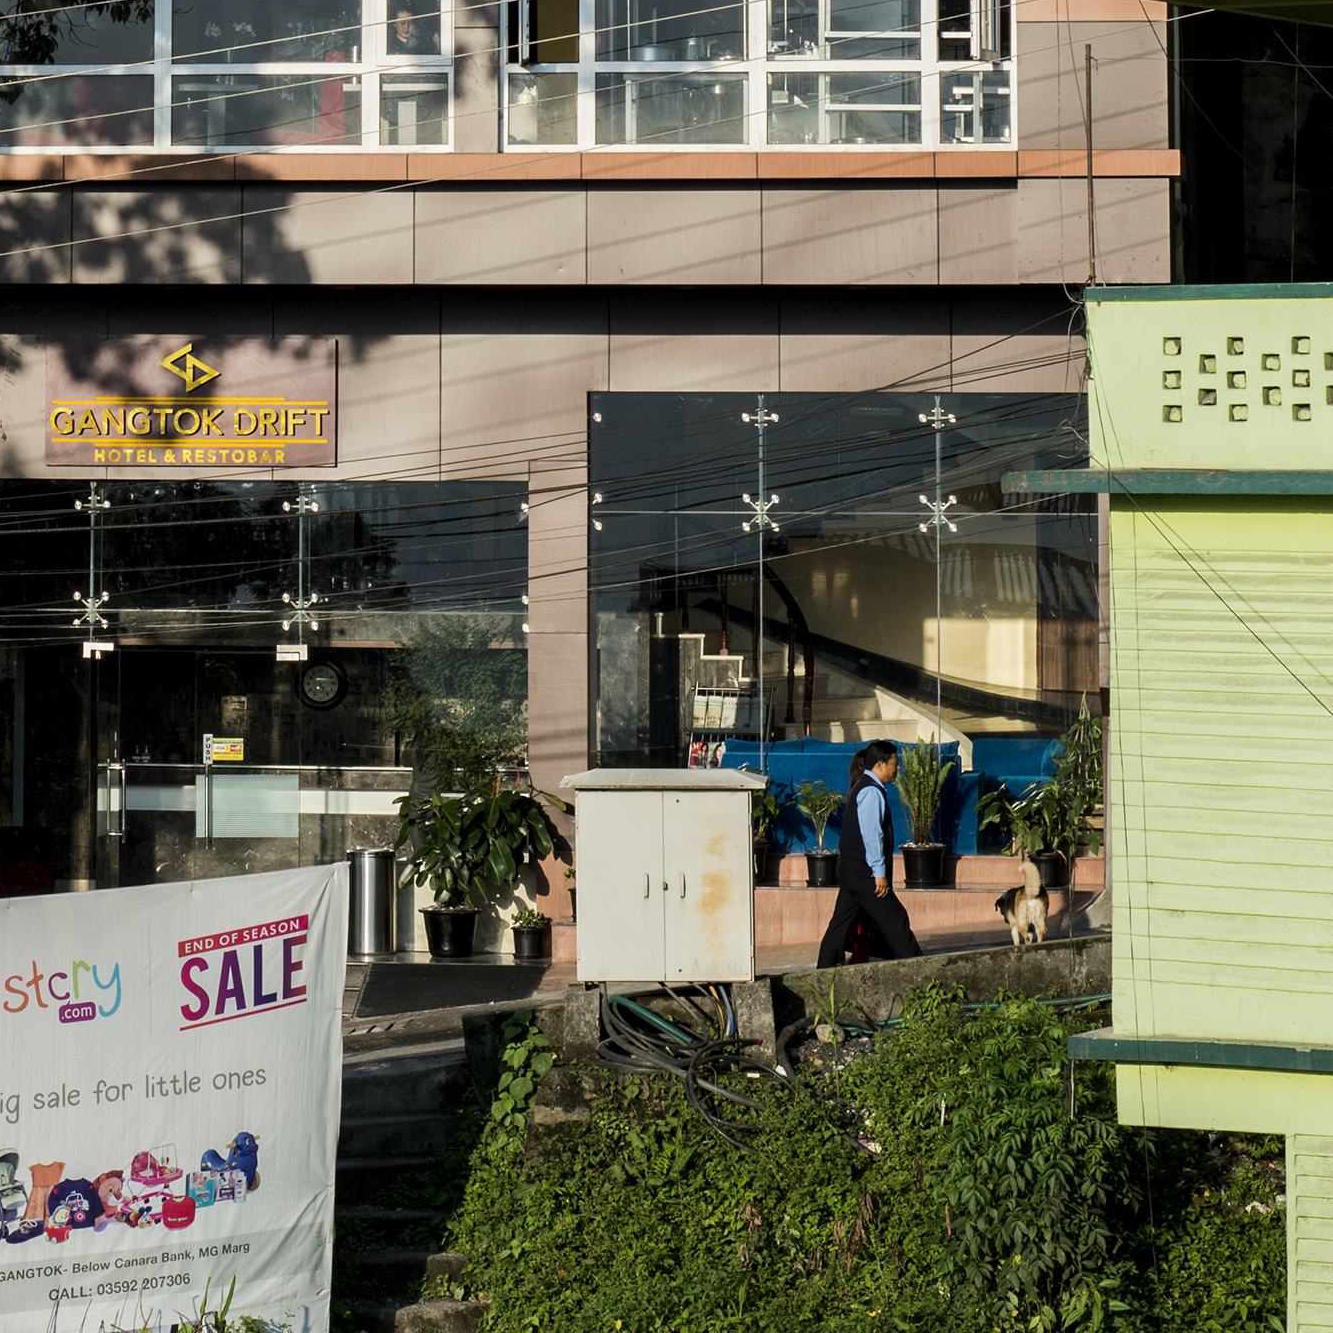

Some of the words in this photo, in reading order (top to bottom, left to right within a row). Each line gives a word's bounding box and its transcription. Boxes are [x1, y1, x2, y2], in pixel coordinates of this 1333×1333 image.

[49, 407, 224, 435] GANGTOK
[233, 408, 330, 436] DRIFT
[94, 449, 157, 463] HOTEL
[163, 449, 176, 463] &
[182, 449, 285, 463] RESTOBAR
[184, 938, 215, 954] END
[219, 933, 239, 947] OF
[243, 919, 300, 941] SEASON
[180, 933, 308, 1022] SALE
[60, 1004, 93, 1020] .com
[33, 1083, 81, 1110] sale
[92, 1080, 133, 1104] for
[145, 1070, 201, 1098] little
[212, 1068, 267, 1090] ones
[72, 1260, 111, 1274] Below
[114, 1255, 158, 1269] Canara
[161, 1249, 195, 1264] Bank,
[198, 1245, 219, 1259] MG
[221, 1242, 251, 1256] Marg
[48, 1285, 93, 1301] CALL:
[96, 1280, 139, 1296] 03592
[142, 1272, 191, 1290] 207306
